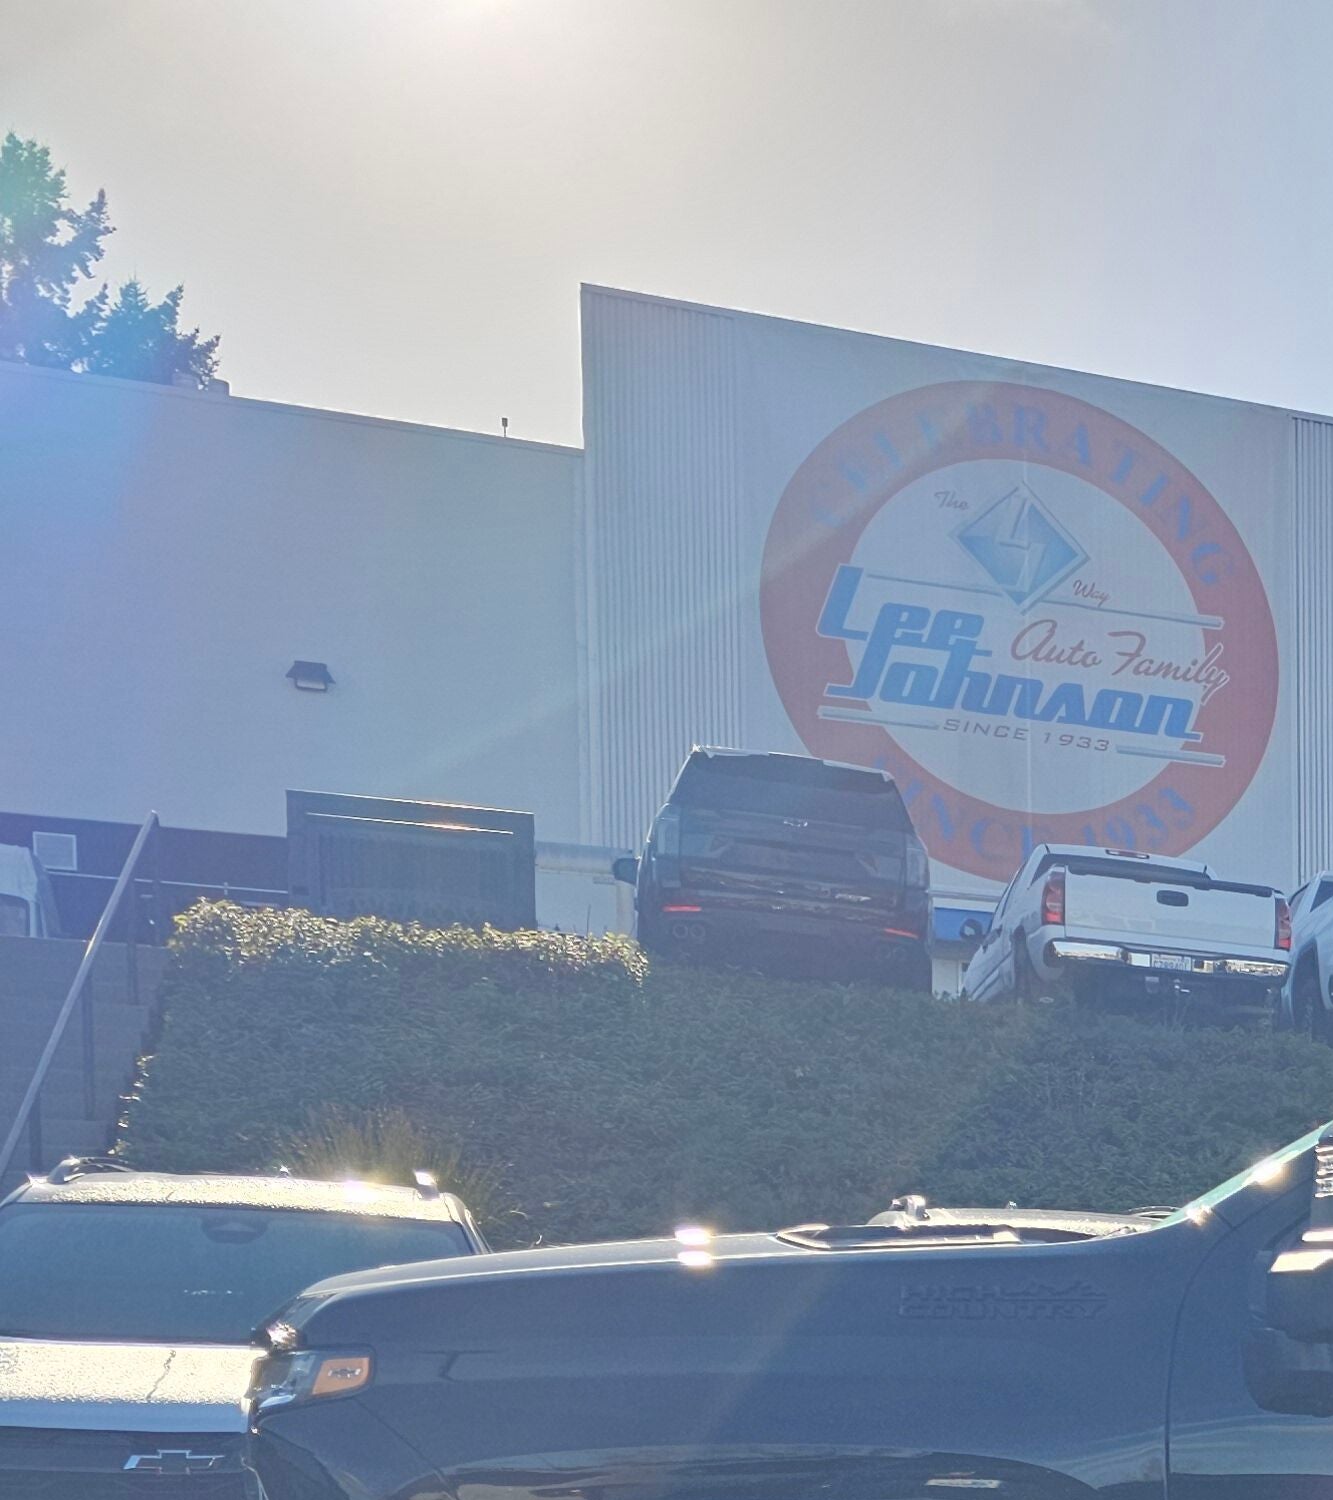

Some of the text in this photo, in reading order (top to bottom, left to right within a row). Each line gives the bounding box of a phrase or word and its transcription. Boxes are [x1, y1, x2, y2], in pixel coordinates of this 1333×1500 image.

[934, 490, 970, 511] The
[817, 564, 992, 657] Lee
[1073, 579, 1110, 608] Way
[824, 626, 1203, 742] Johnson
[1010, 618, 1230, 703] Auto Family
[943, 718, 1111, 753] SINCE 1933
